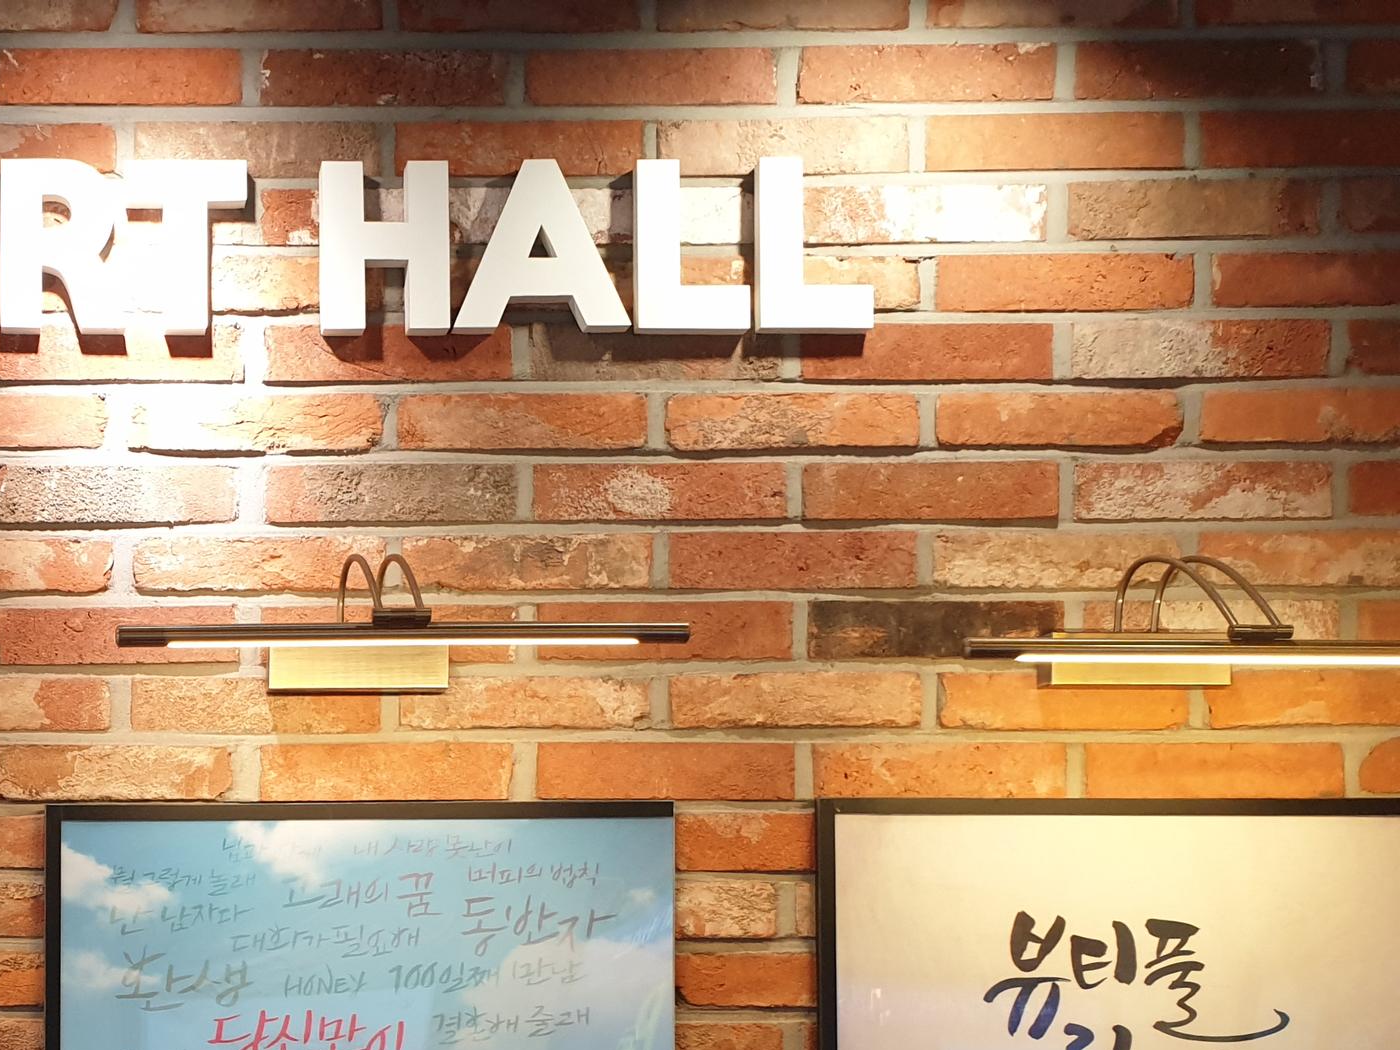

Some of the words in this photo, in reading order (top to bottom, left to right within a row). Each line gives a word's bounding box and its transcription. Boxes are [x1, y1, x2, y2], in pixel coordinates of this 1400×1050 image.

[317, 155, 874, 336] HALL
[143, 866, 202, 892] 그렇게
[208, 868, 256, 896] 놀래
[281, 877, 388, 910] 고래의
[397, 871, 442, 918] 꿈
[468, 862, 542, 884] 머피의
[551, 862, 600, 888] 법칙
[109, 904, 152, 936] 난
[160, 902, 255, 934] 남자다
[461, 895, 617, 957] 동반자
[230, 923, 331, 952] 대화가
[333, 924, 420, 959] 필요해
[115, 945, 254, 1012] 환생
[284, 963, 366, 998] HONEY
[983, 910, 1290, 1042] 뷰티풀
[432, 1006, 519, 1045] 결혼해
[525, 1005, 590, 1037] 줄래
